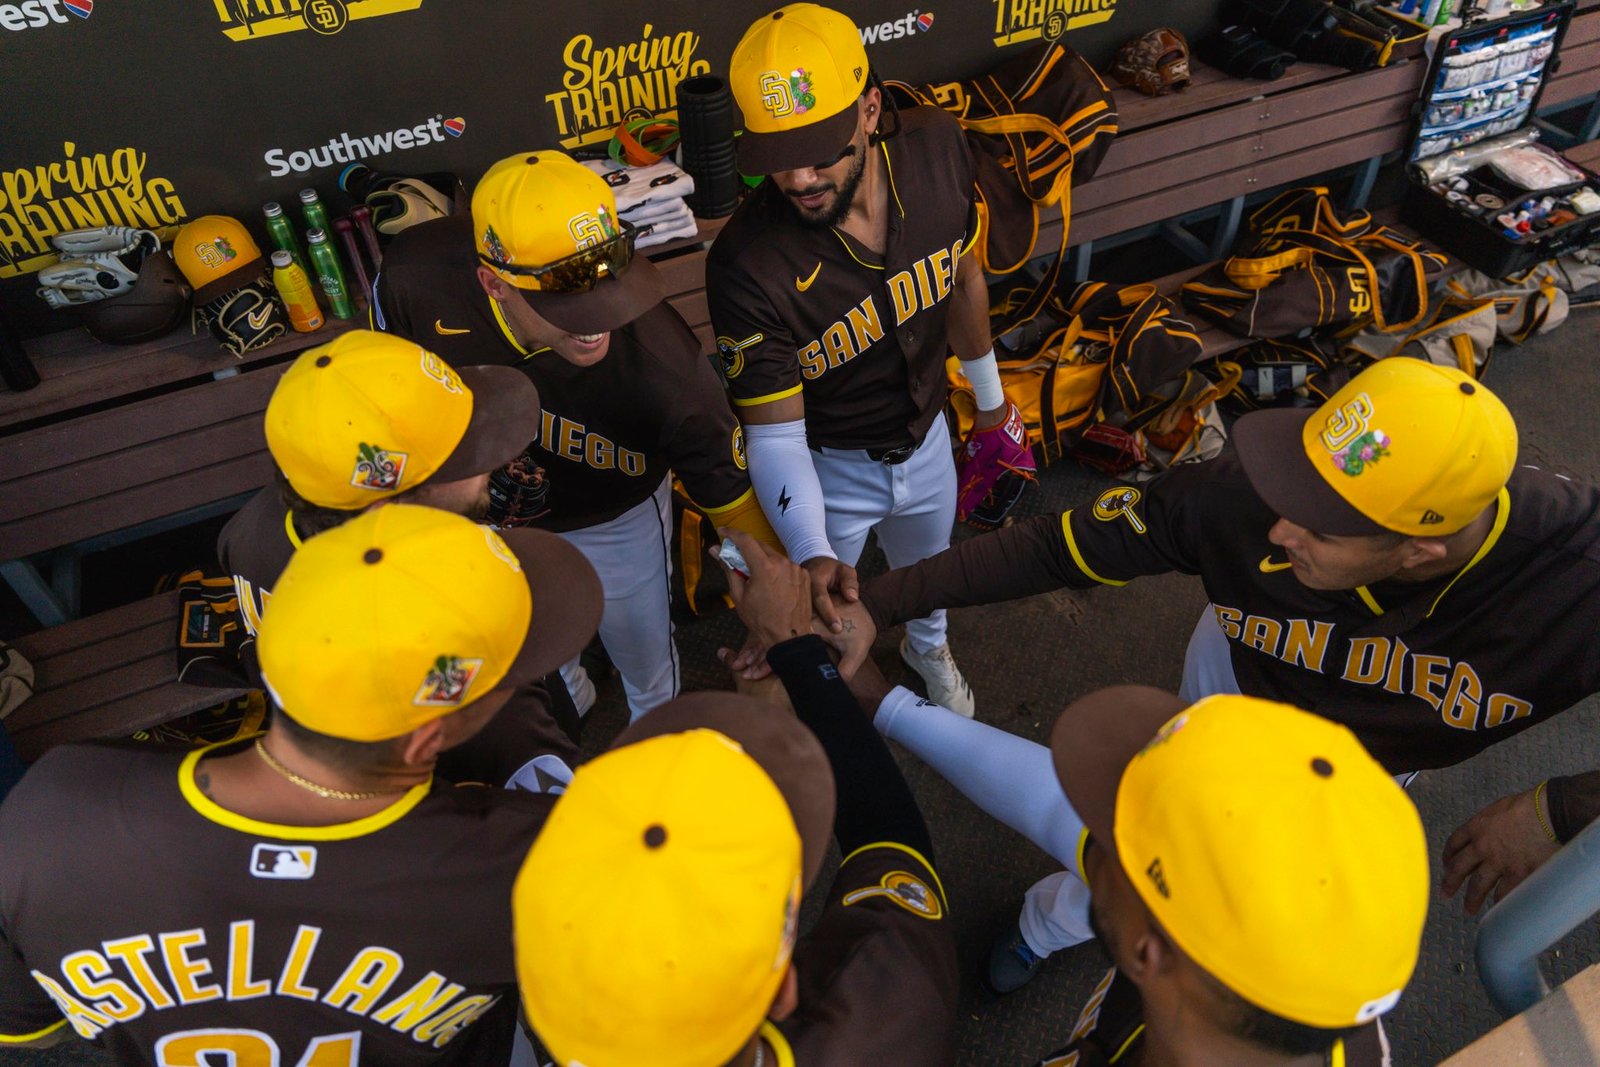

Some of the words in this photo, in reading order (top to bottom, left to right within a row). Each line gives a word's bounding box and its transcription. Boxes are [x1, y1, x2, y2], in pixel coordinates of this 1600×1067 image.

[563, 24, 699, 101] Spring
[0, 141, 147, 225] pring
[264, 117, 446, 177] Southwest
[797, 294, 886, 380] SAN
[531, 408, 646, 477] IEGO
[1212, 602, 1336, 674] SAN
[1340, 635, 1533, 731] DIEGO
